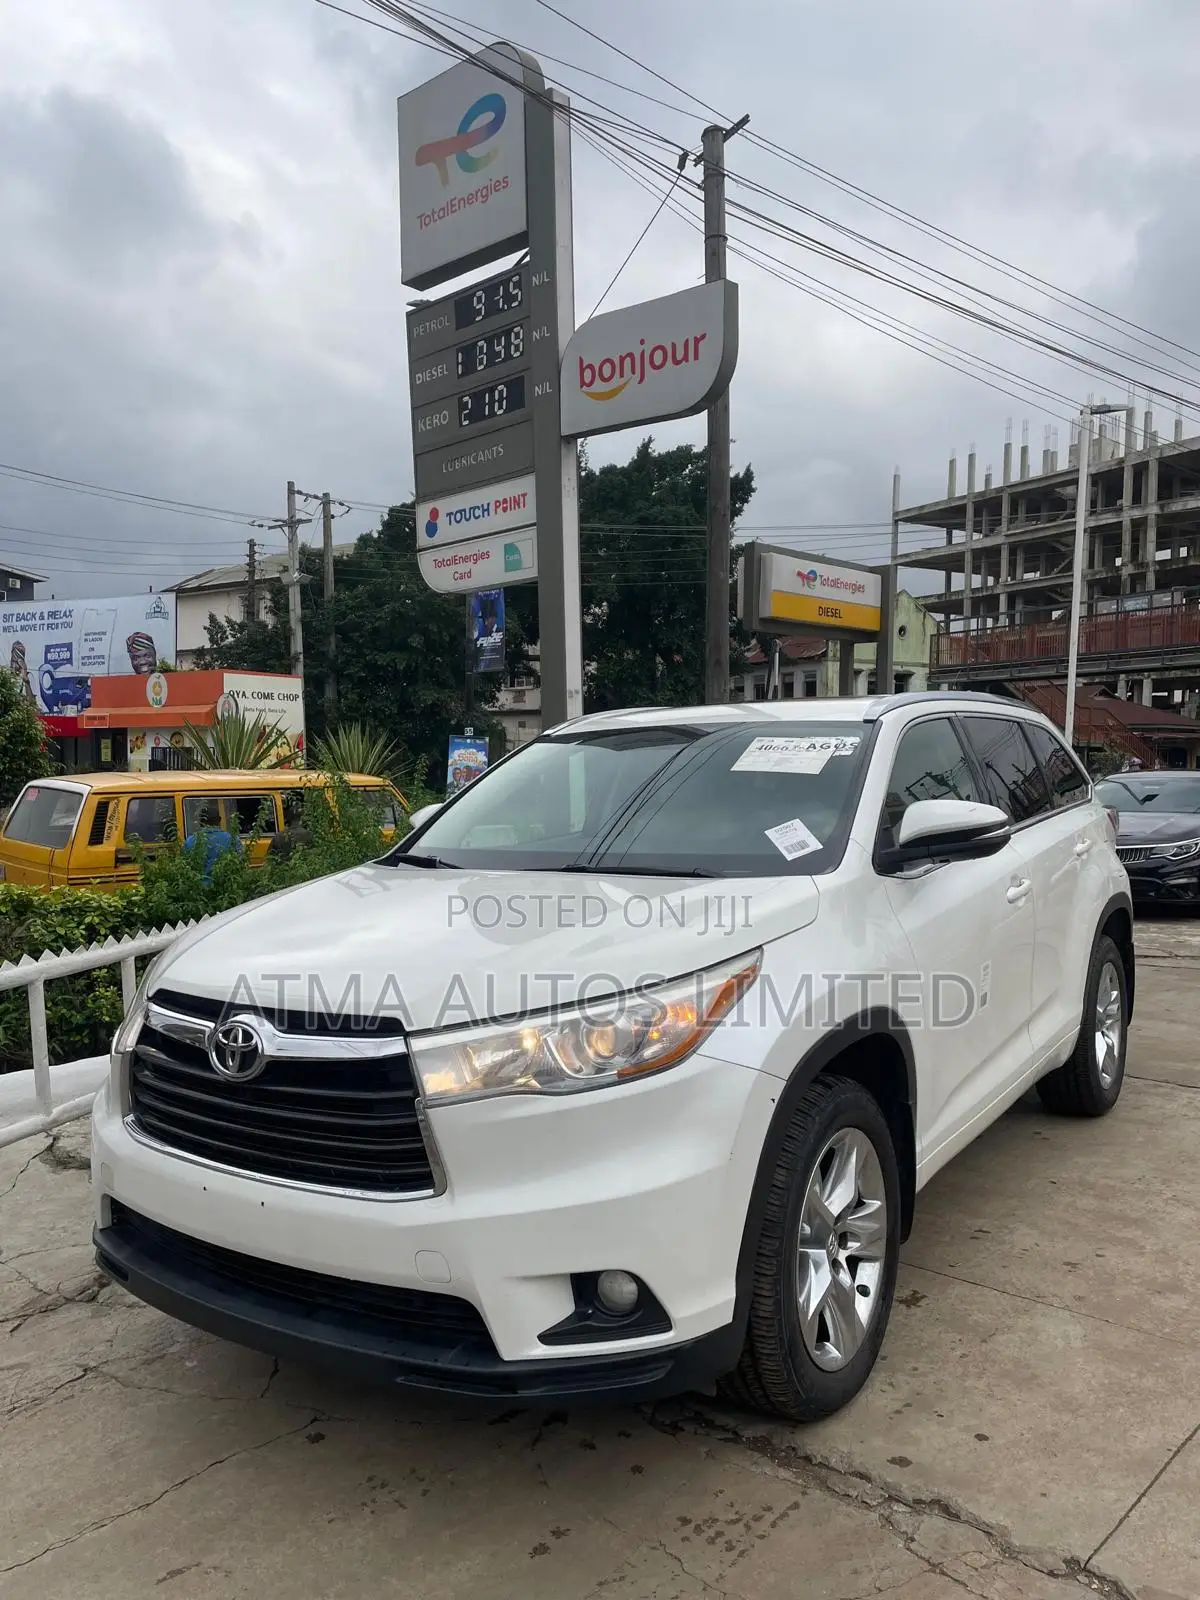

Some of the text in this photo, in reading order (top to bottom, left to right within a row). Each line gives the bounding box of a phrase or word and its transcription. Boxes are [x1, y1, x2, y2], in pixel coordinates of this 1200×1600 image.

[417, 176, 509, 231] TotalEnergies
[413, 315, 450, 337] PETROL
[532, 271, 551, 287] N/L
[415, 365, 448, 385] DIESEL
[532, 325, 551, 342] N/L
[579, 332, 707, 389] bonjour
[418, 381, 553, 433] KERO 210 N/L
[442, 444, 504, 473] LUBRICANTS
[446, 492, 528, 526] TOUCH POINT
[433, 549, 491, 570] TotalEnergies
[453, 569, 472, 581] Card
[819, 574, 866, 594] TotalEnergies
[2, 609, 74, 623] SIT BACK & RELAX
[818, 605, 843, 619] DIESEL
[20, 623, 38, 632] MOVE
[39, 623, 46, 631] IT
[47, 622, 59, 631] FOR
[60, 621, 74, 630] YOU
[251, 691, 275, 700] COME
[277, 692, 300, 702] CHOP
